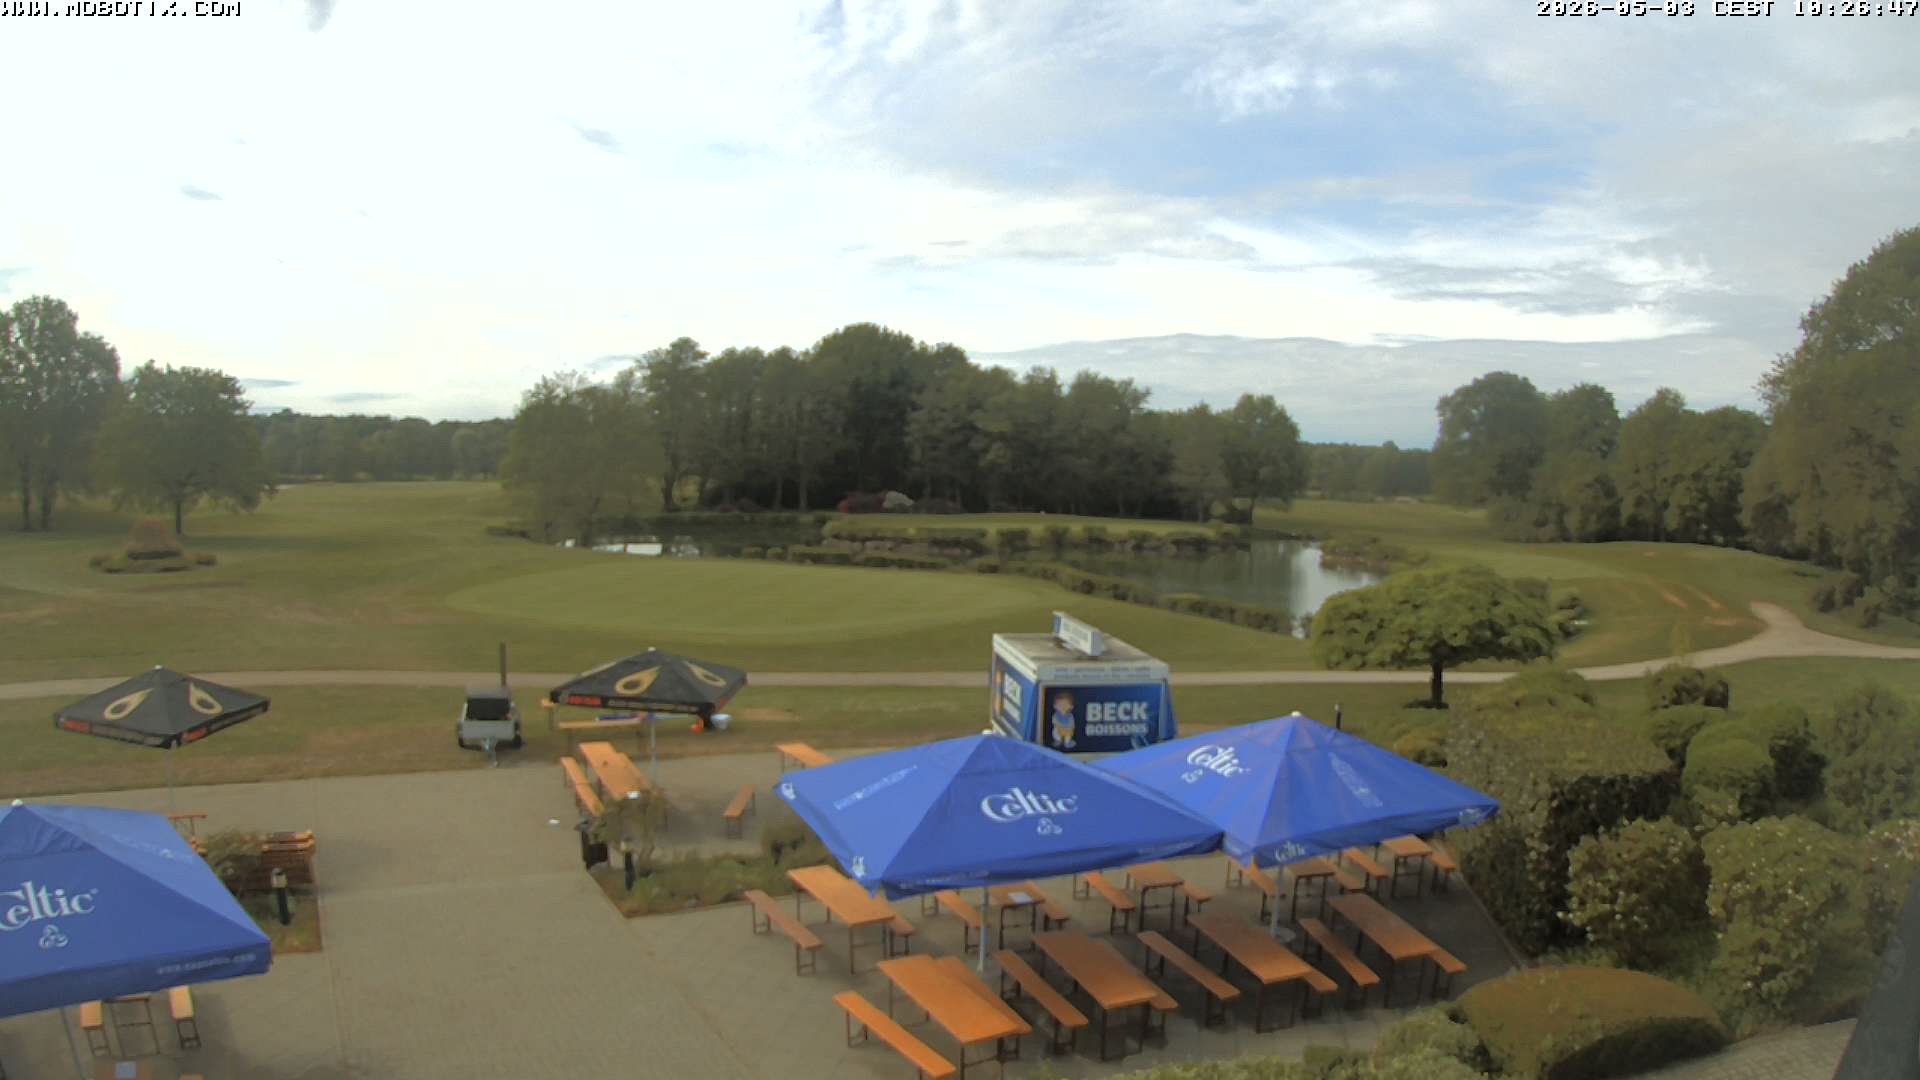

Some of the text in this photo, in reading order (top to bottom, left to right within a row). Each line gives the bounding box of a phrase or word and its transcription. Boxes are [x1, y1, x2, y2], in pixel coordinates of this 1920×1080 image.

[1086, 702, 1148, 721] BECK
[1187, 745, 1243, 777] Celtic
[981, 787, 1075, 821] Celtic
